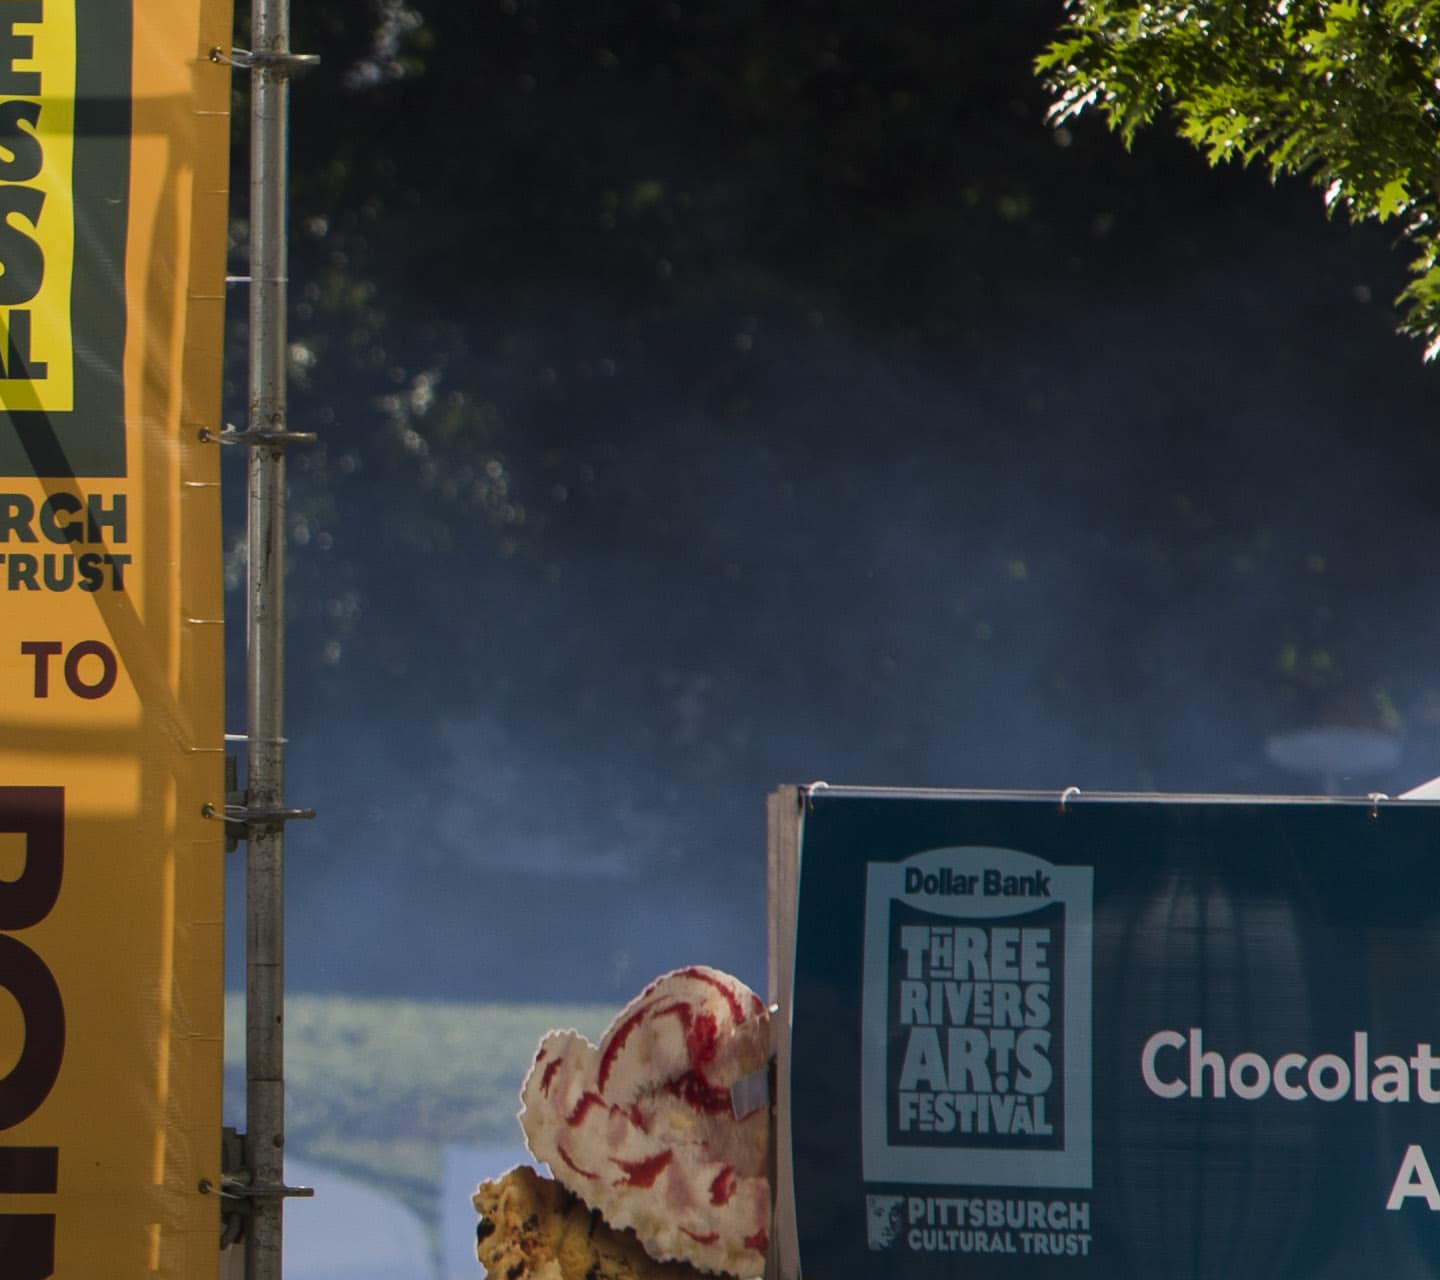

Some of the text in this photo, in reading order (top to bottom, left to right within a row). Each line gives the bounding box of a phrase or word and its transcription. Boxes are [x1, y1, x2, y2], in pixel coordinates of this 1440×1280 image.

[21, 639, 118, 700] TO
[905, 868, 1051, 897] Dollar Bank
[900, 926, 1051, 982] THREE
[900, 981, 1051, 1028] RIVERS
[898, 1028, 1053, 1094] ARTS
[899, 1092, 1053, 1136] FESTIVAL
[908, 1198, 1090, 1229] PITTSBURGH
[908, 1229, 1092, 1256] CULTURAL TRUST
